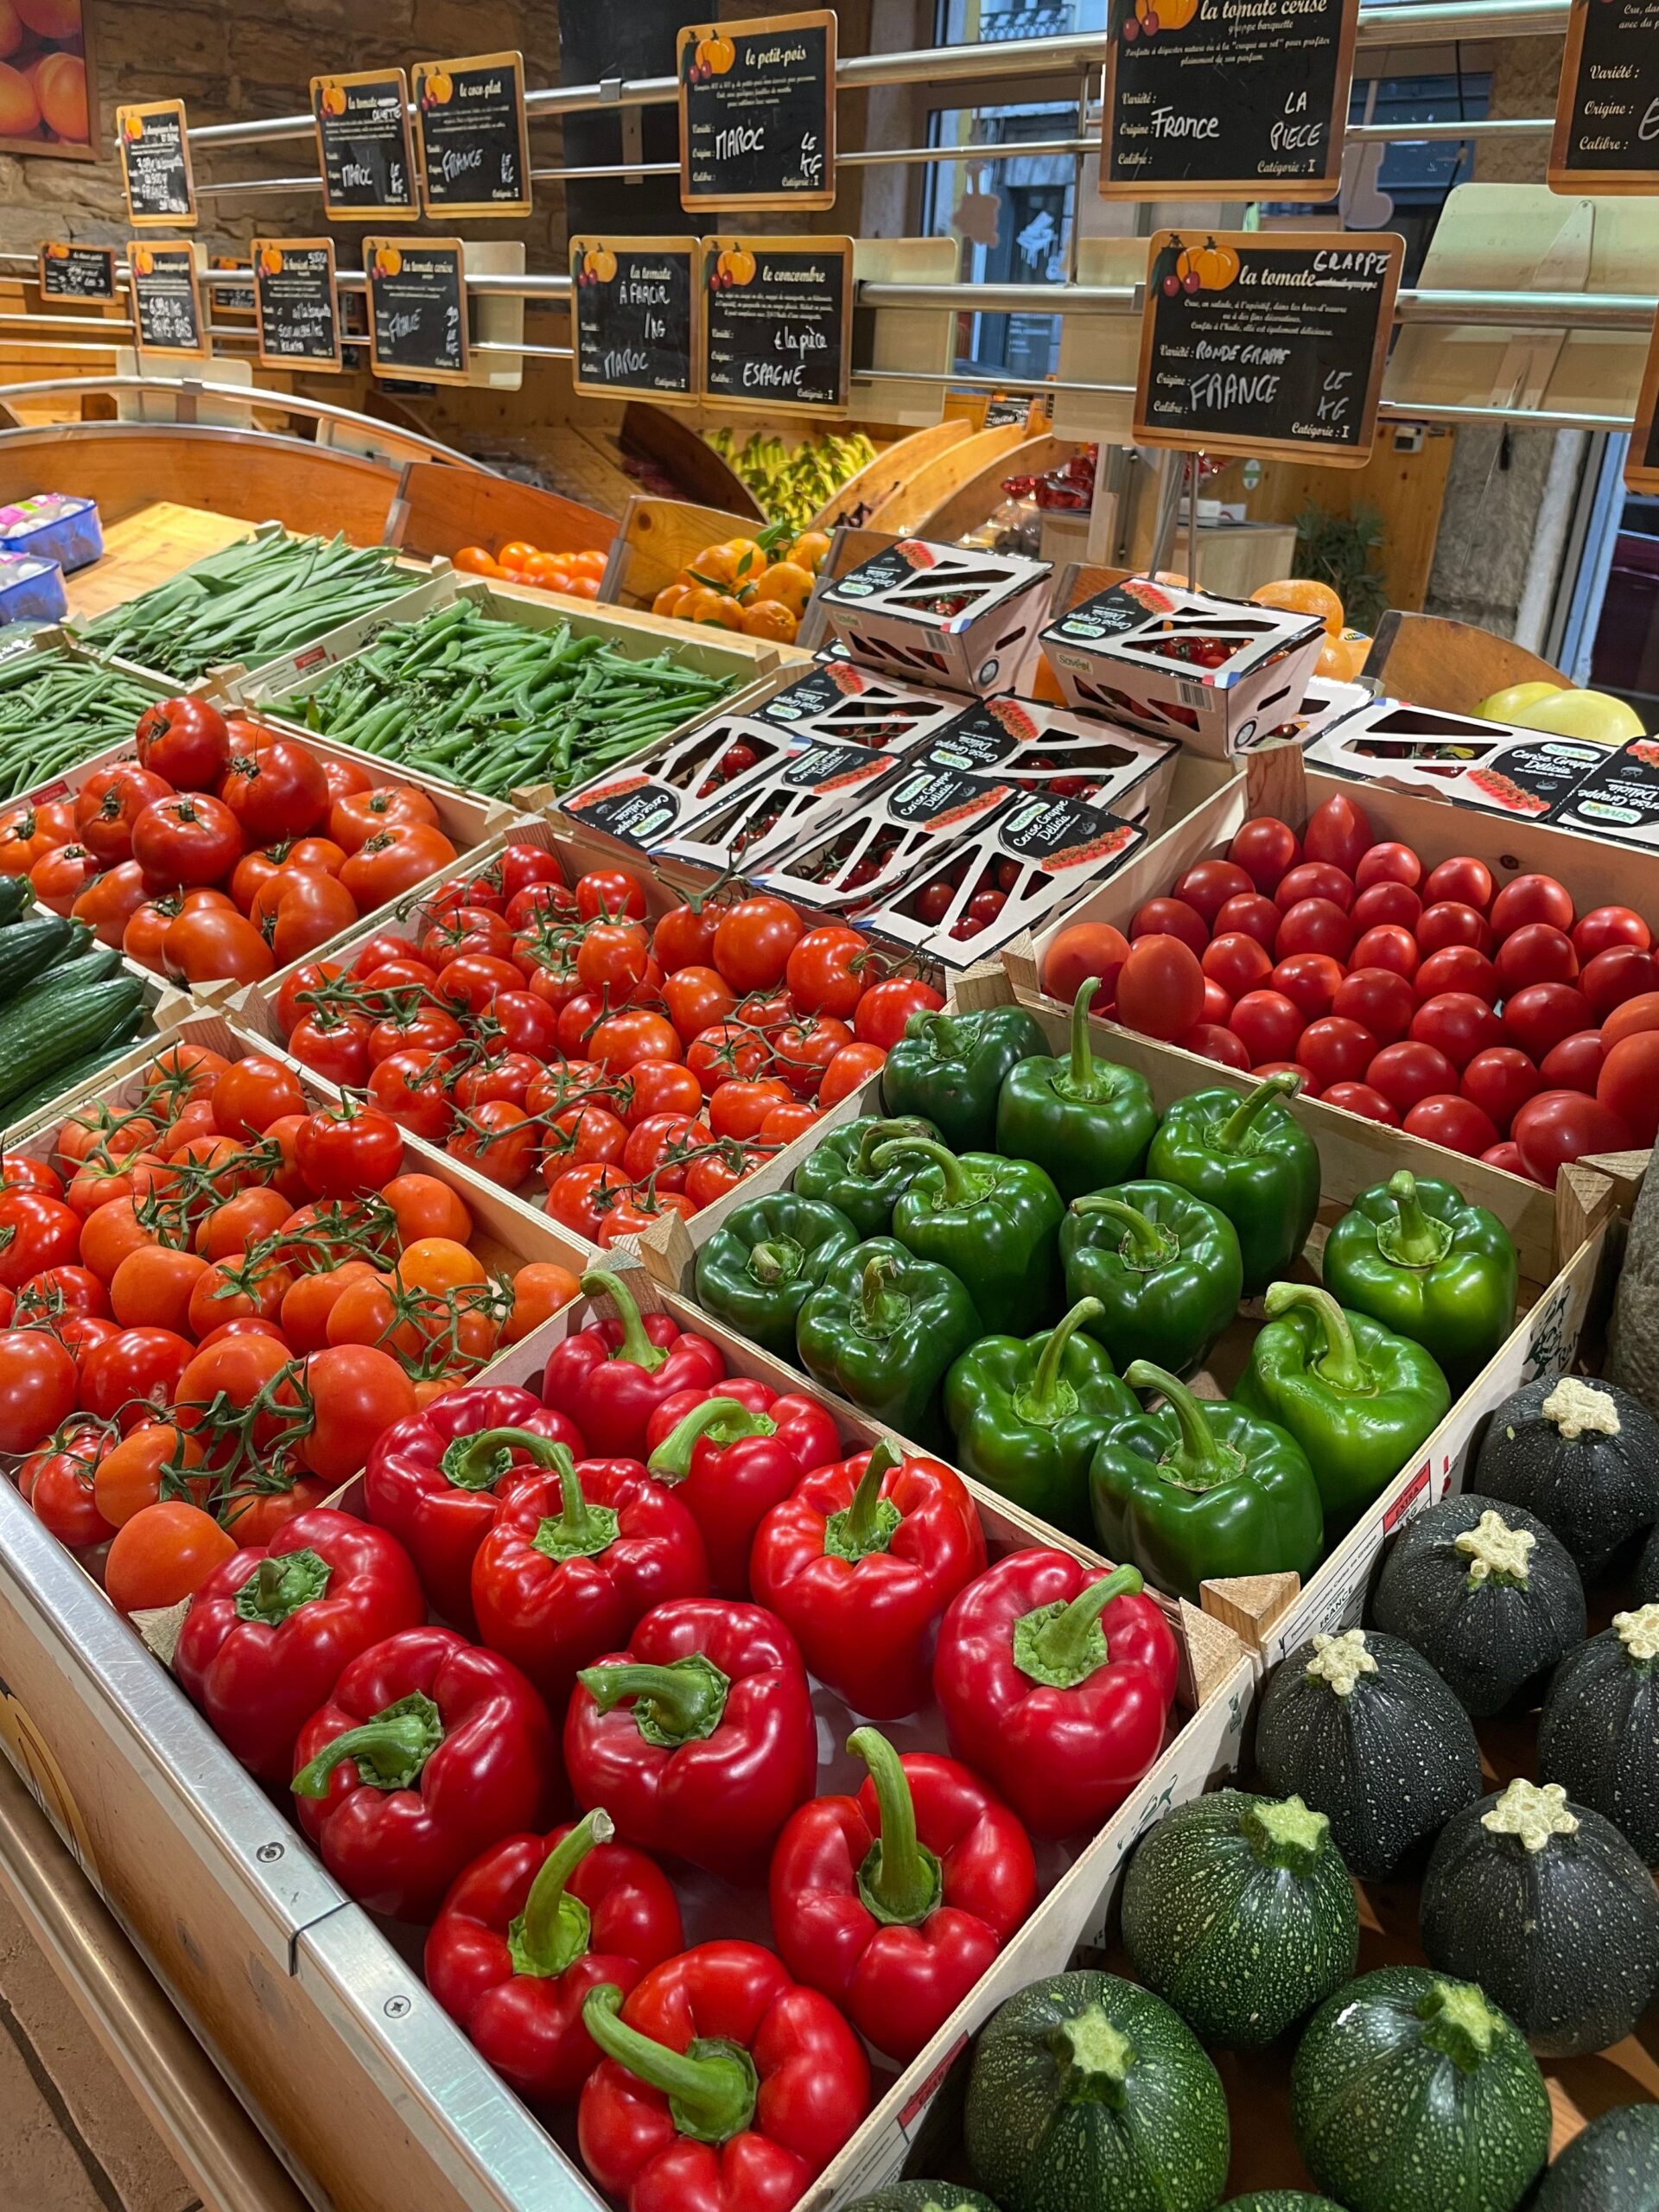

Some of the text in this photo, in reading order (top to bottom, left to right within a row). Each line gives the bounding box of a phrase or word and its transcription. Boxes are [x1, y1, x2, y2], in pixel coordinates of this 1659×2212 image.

[1200, 0, 1219, 20] la
[1223, 0, 1277, 18] tomate
[1257, 19, 1294, 32] barquette
[746, 44, 807, 69] le petit-pois
[1590, 65, 1633, 79] Variété
[1284, 92, 1307, 114] LA
[1584, 100, 1626, 118] Origine
[1120, 124, 1148, 137] Origine
[715, 126, 765, 161] MAROC
[801, 132, 817, 150] LE
[1580, 136, 1621, 150] Calibre
[1118, 153, 1147, 165] Calibre
[1257, 159, 1299, 175] Catégorie
[1313, 251, 1392, 276] GRAPPE
[1239, 265, 1257, 285] la
[1261, 267, 1316, 288] tomate
[605, 348, 649, 379] MAROC
[742, 362, 807, 387] ESPAGNE
[1323, 370, 1352, 391] LE
[1156, 372, 1281, 412] Origine FRANCE
[1153, 400, 1182, 415] Calibre
[1316, 396, 1350, 421] KG
[1292, 422, 1333, 438] Catégorie
[1512, 749, 1552, 763] Cerise
[1524, 760, 1571, 774] Délicia
[900, 772, 952, 816] Cerise Grappe
[1578, 789, 1628, 806] Grappe
[1607, 784, 1659, 801] Délicia
[1013, 823, 1042, 846] Cerise
[1036, 800, 1069, 824] Grappe
[1037, 815, 1071, 841] Délicia
[1319, 1584, 1354, 1629] FRANCE
